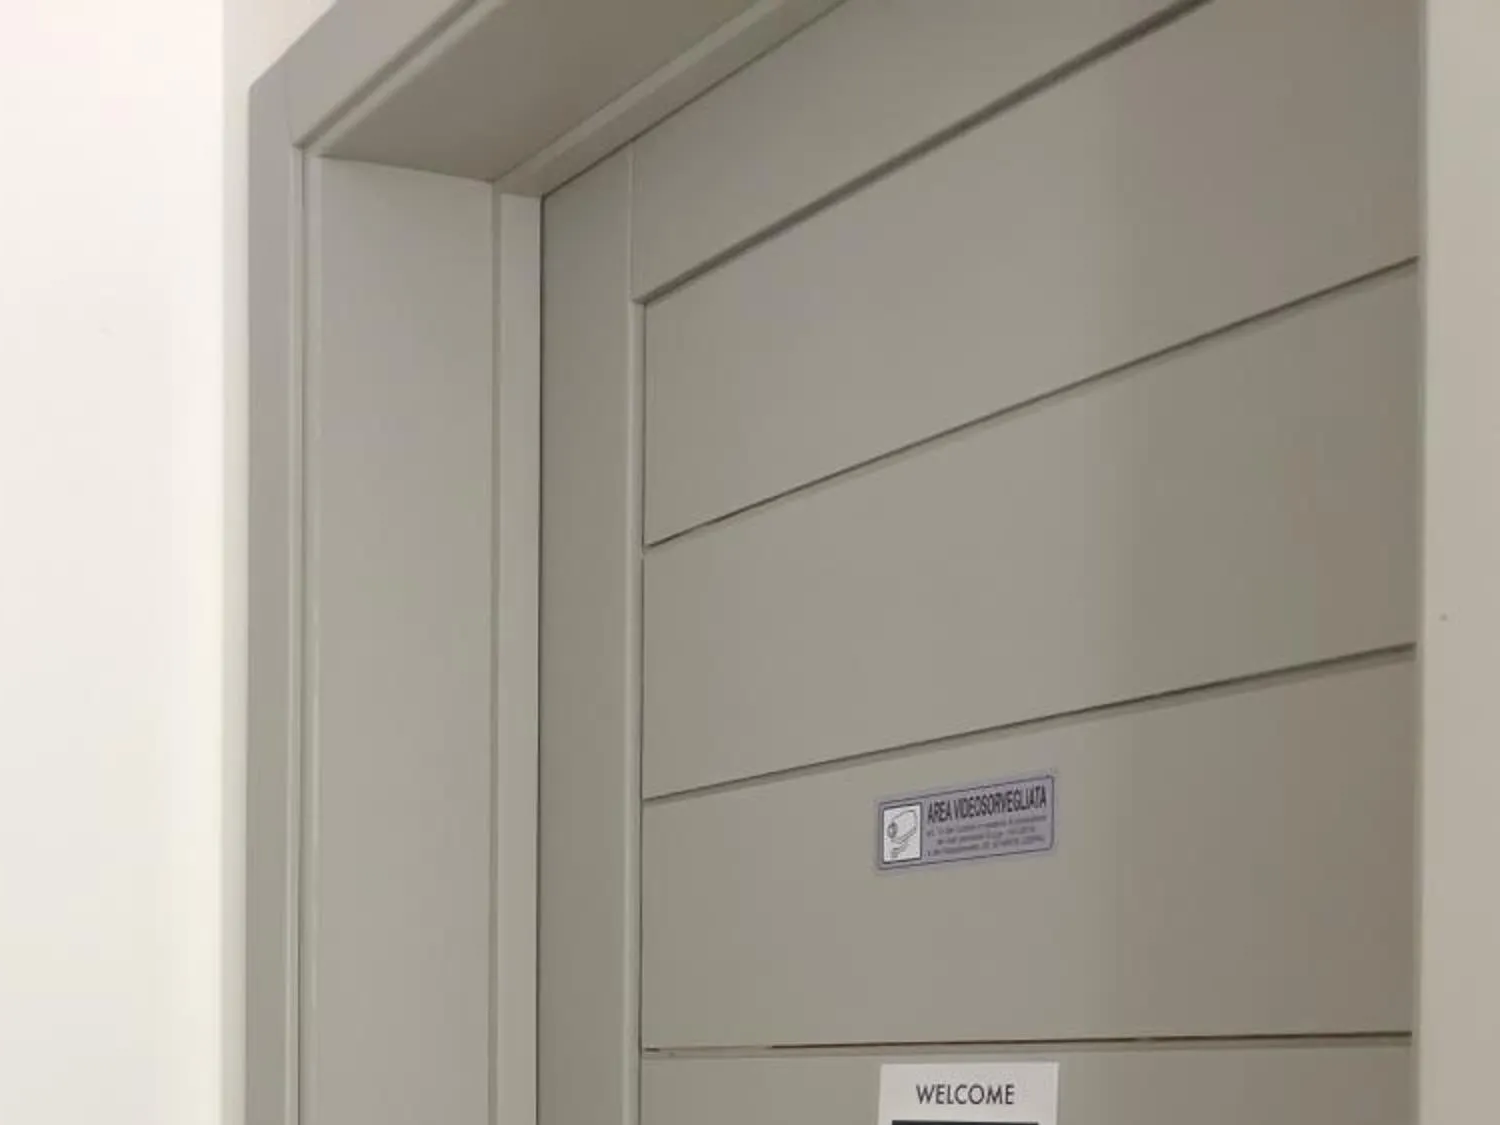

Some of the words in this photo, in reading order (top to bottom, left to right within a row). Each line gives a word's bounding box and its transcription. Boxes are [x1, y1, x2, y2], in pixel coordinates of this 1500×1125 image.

[927, 799, 952, 824] AREA
[954, 785, 1047, 821] VIDEOSORVEGLIATA
[915, 1083, 1015, 1105] WELCOME
